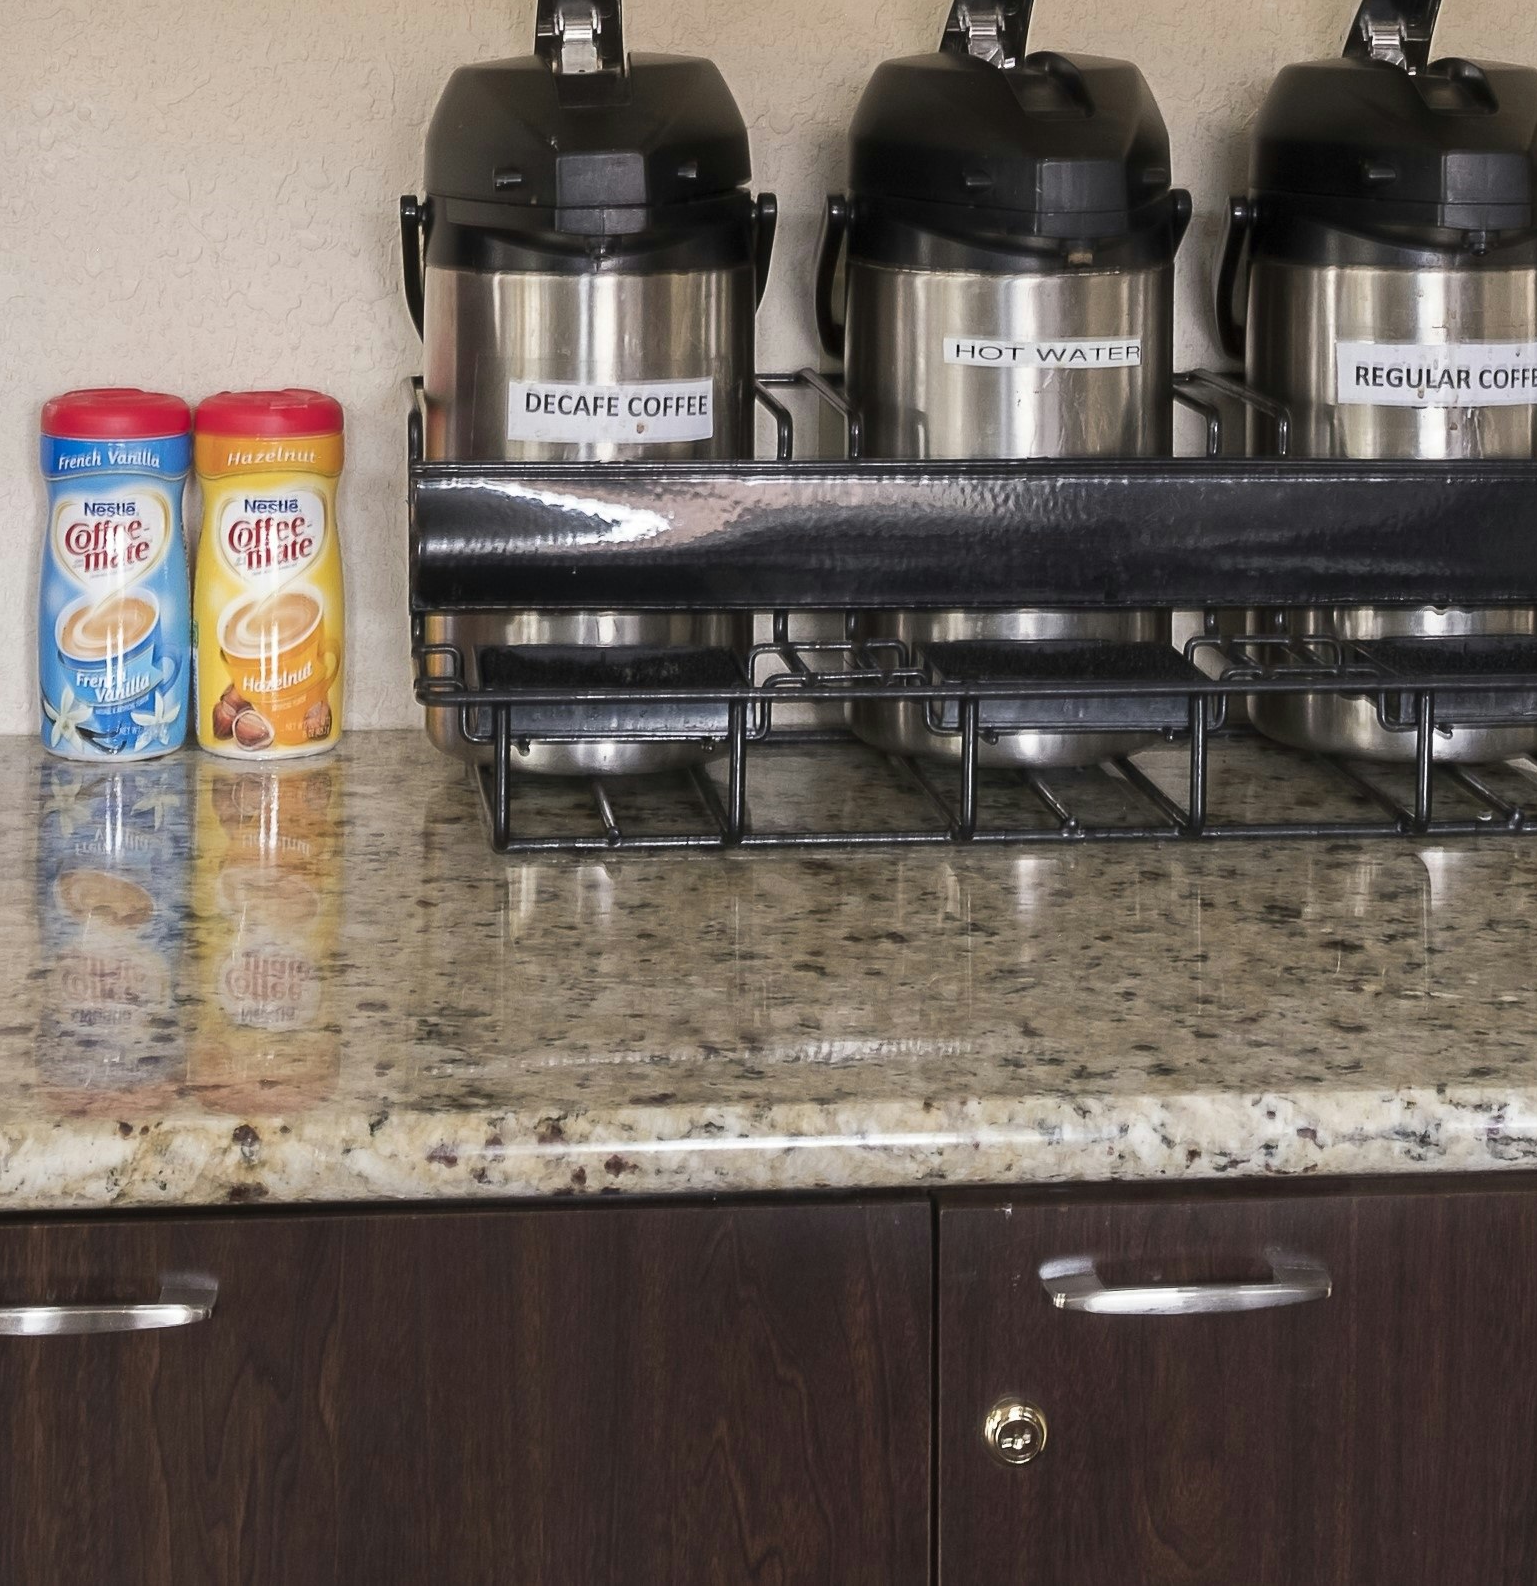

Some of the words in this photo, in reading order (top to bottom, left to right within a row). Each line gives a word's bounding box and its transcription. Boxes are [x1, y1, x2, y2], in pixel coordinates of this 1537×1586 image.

[955, 343, 1025, 362] HOT
[1036, 345, 1141, 362] WATER
[1355, 365, 1471, 390] REGULAR
[525, 391, 619, 417] DECAFE
[627, 394, 708, 417] COFFEE
[59, 448, 101, 470] French
[107, 449, 160, 469] Vanilla
[227, 447, 317, 467] Hazelnut
[95, 673, 151, 703] Vanilla
